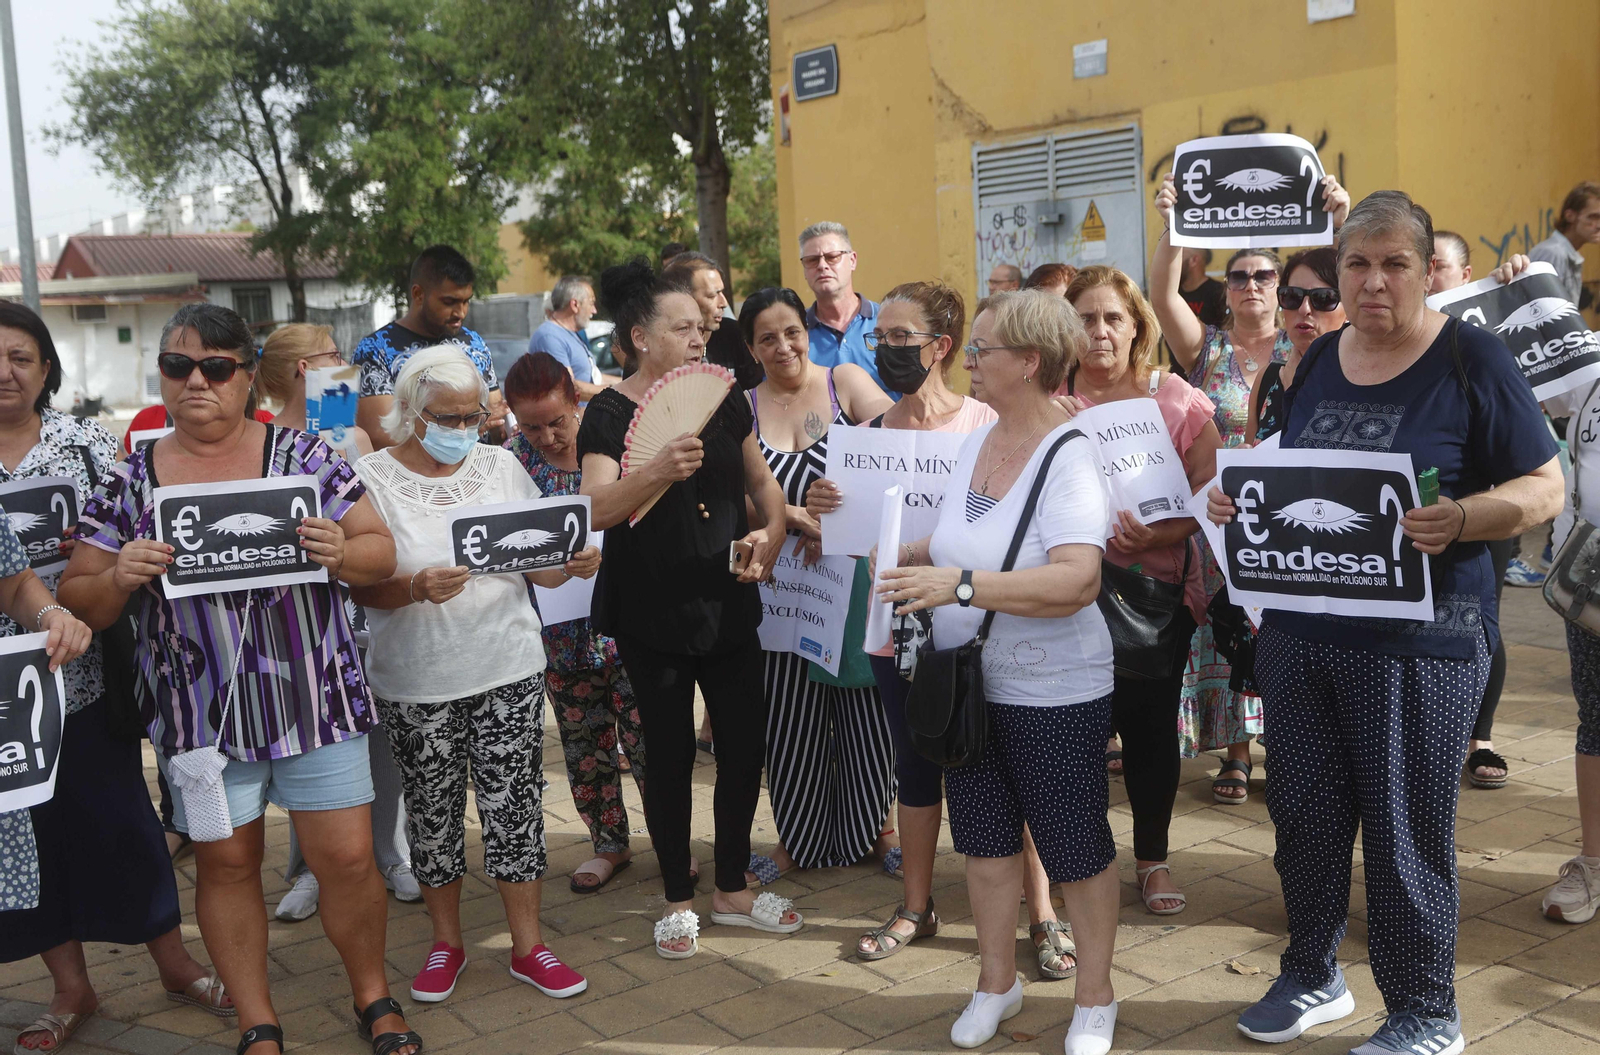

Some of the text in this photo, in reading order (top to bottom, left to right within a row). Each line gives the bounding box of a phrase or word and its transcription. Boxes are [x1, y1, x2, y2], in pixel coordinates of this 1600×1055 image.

[1183, 158, 1212, 205] €
[1183, 202, 1301, 222] endesa
[1096, 421, 1160, 446] MÍNIMA
[843, 452, 908, 473] RENTA
[1235, 479, 1270, 544] €
[171, 505, 204, 551] €
[175, 544, 296, 568] endesa
[461, 524, 490, 565] €
[223, 561, 255, 572] NORMALIDAD
[261, 558, 287, 568] POLÍGONO
[286, 557, 297, 565] SUR
[773, 555, 844, 587] ENTA MÍNIMA
[1236, 546, 1387, 574] endesa
[1257, 570, 1273, 580] habrá
[1272, 571, 1281, 581] luz
[1281, 573, 1293, 581] con
[1292, 573, 1332, 583] NORMALIDAD
[1332, 576, 1340, 584] en
[1340, 573, 1373, 586] POLÍGONO
[1373, 577, 1388, 587] SUR
[761, 602, 826, 629] EXCLUSIÓN
[13, 762, 29, 775] SUR
